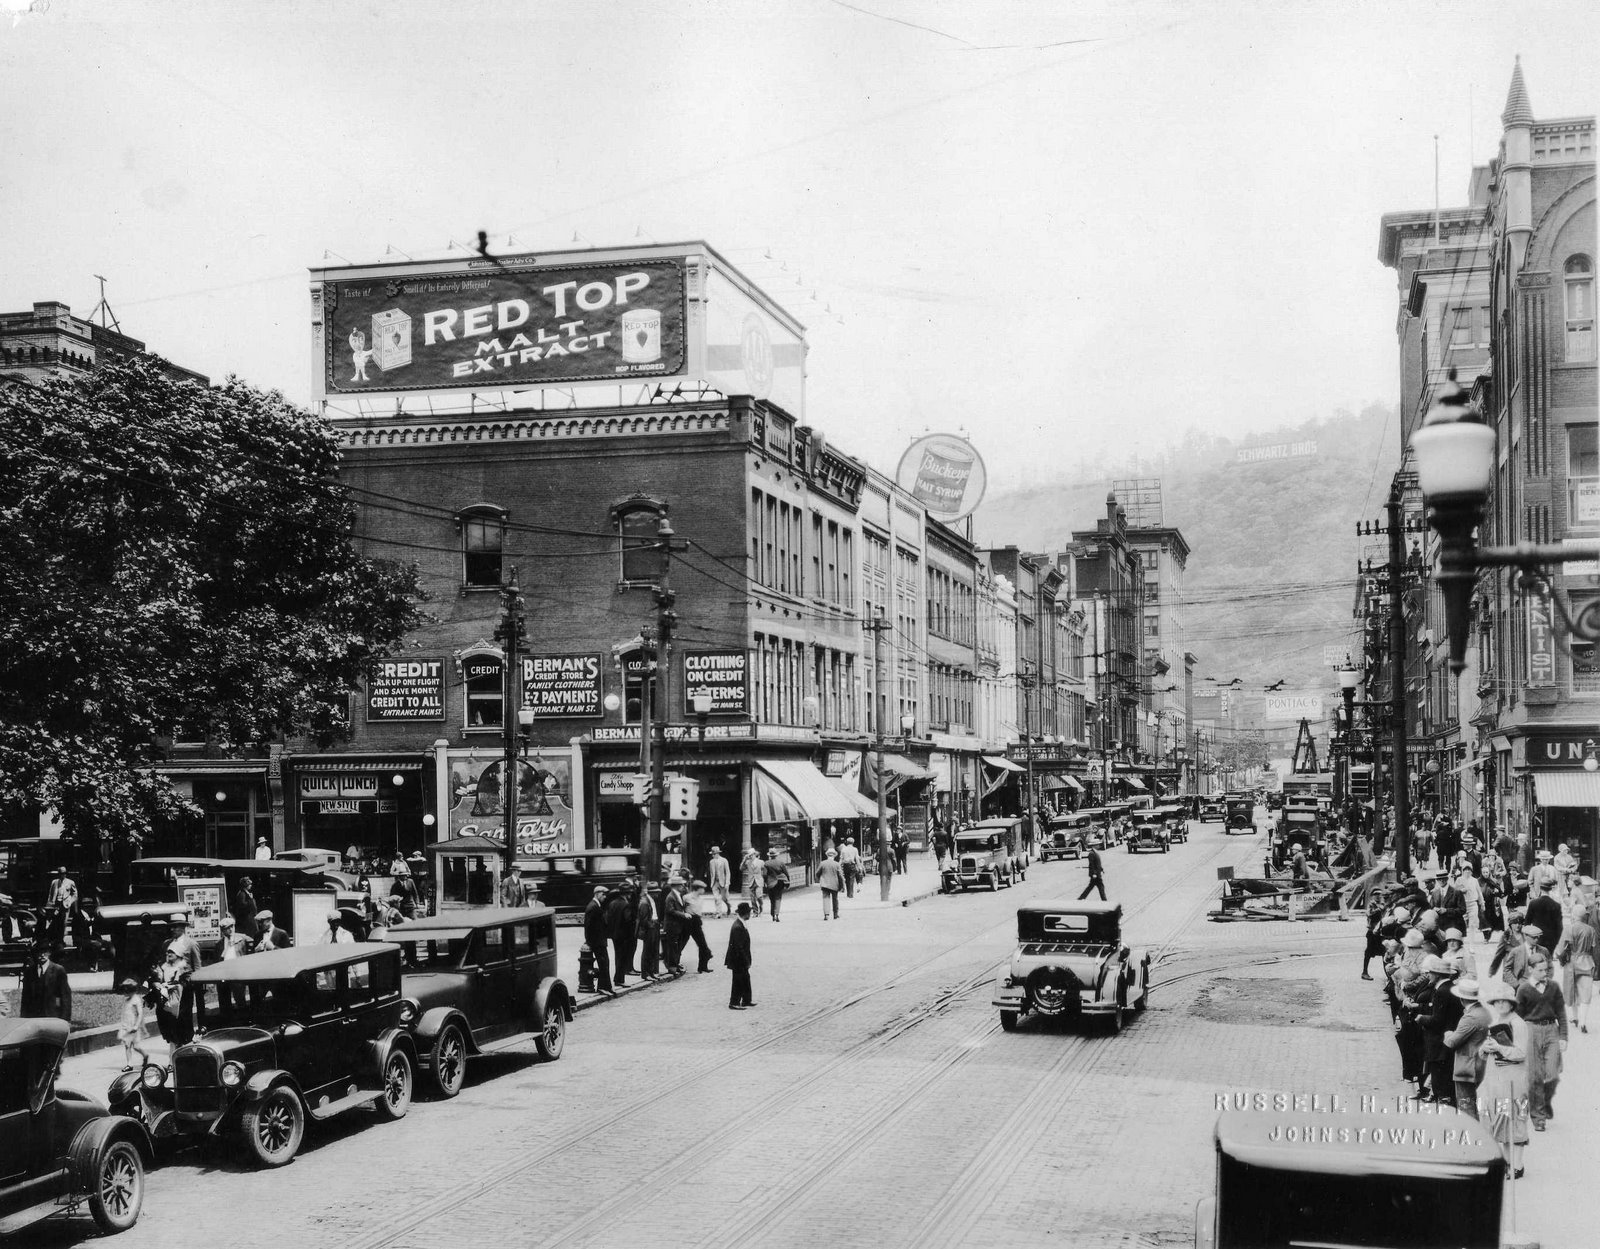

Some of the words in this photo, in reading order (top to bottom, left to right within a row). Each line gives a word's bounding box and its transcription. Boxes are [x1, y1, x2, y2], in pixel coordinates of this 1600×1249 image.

[437, 282, 460, 294] Entirely
[462, 280, 490, 290] Different!
[424, 299, 530, 346] RED
[543, 272, 650, 318] TOP
[624, 322, 640, 332] RED
[642, 320, 659, 329] TOP
[474, 320, 584, 356] MALT
[453, 332, 612, 378] EXTRACT
[1237, 444, 1288, 461] SCHWARTZ
[1292, 440, 1318, 456] BROS
[920, 455, 970, 484] Buckeye
[935, 486, 962, 498] SYRUP
[524, 656, 598, 680] BERMAN'S
[686, 655, 745, 669] CLOTHING
[470, 666, 499, 674] CREDIT
[687, 671, 704, 682] ON
[704, 670, 744, 681] CREDIT
[554, 680, 595, 688] CLOTHIERS
[370, 697, 404, 707] CREDIT
[406, 697, 419, 707] TO
[422, 697, 440, 706] ALL
[542, 690, 598, 704] PAYMENTS
[1269, 698, 1308, 708] PONTIAC
[1312, 697, 1318, 706] 6
[691, 726, 728, 737] SORE
[302, 778, 336, 792] QUICK
[342, 778, 376, 790] LUNCH
[600, 780, 616, 790] Candy
[617, 780, 634, 790] Shopp
[321, 800, 336, 810] NEW
[337, 800, 357, 811] STYLE
[525, 842, 568, 854] CREAM
